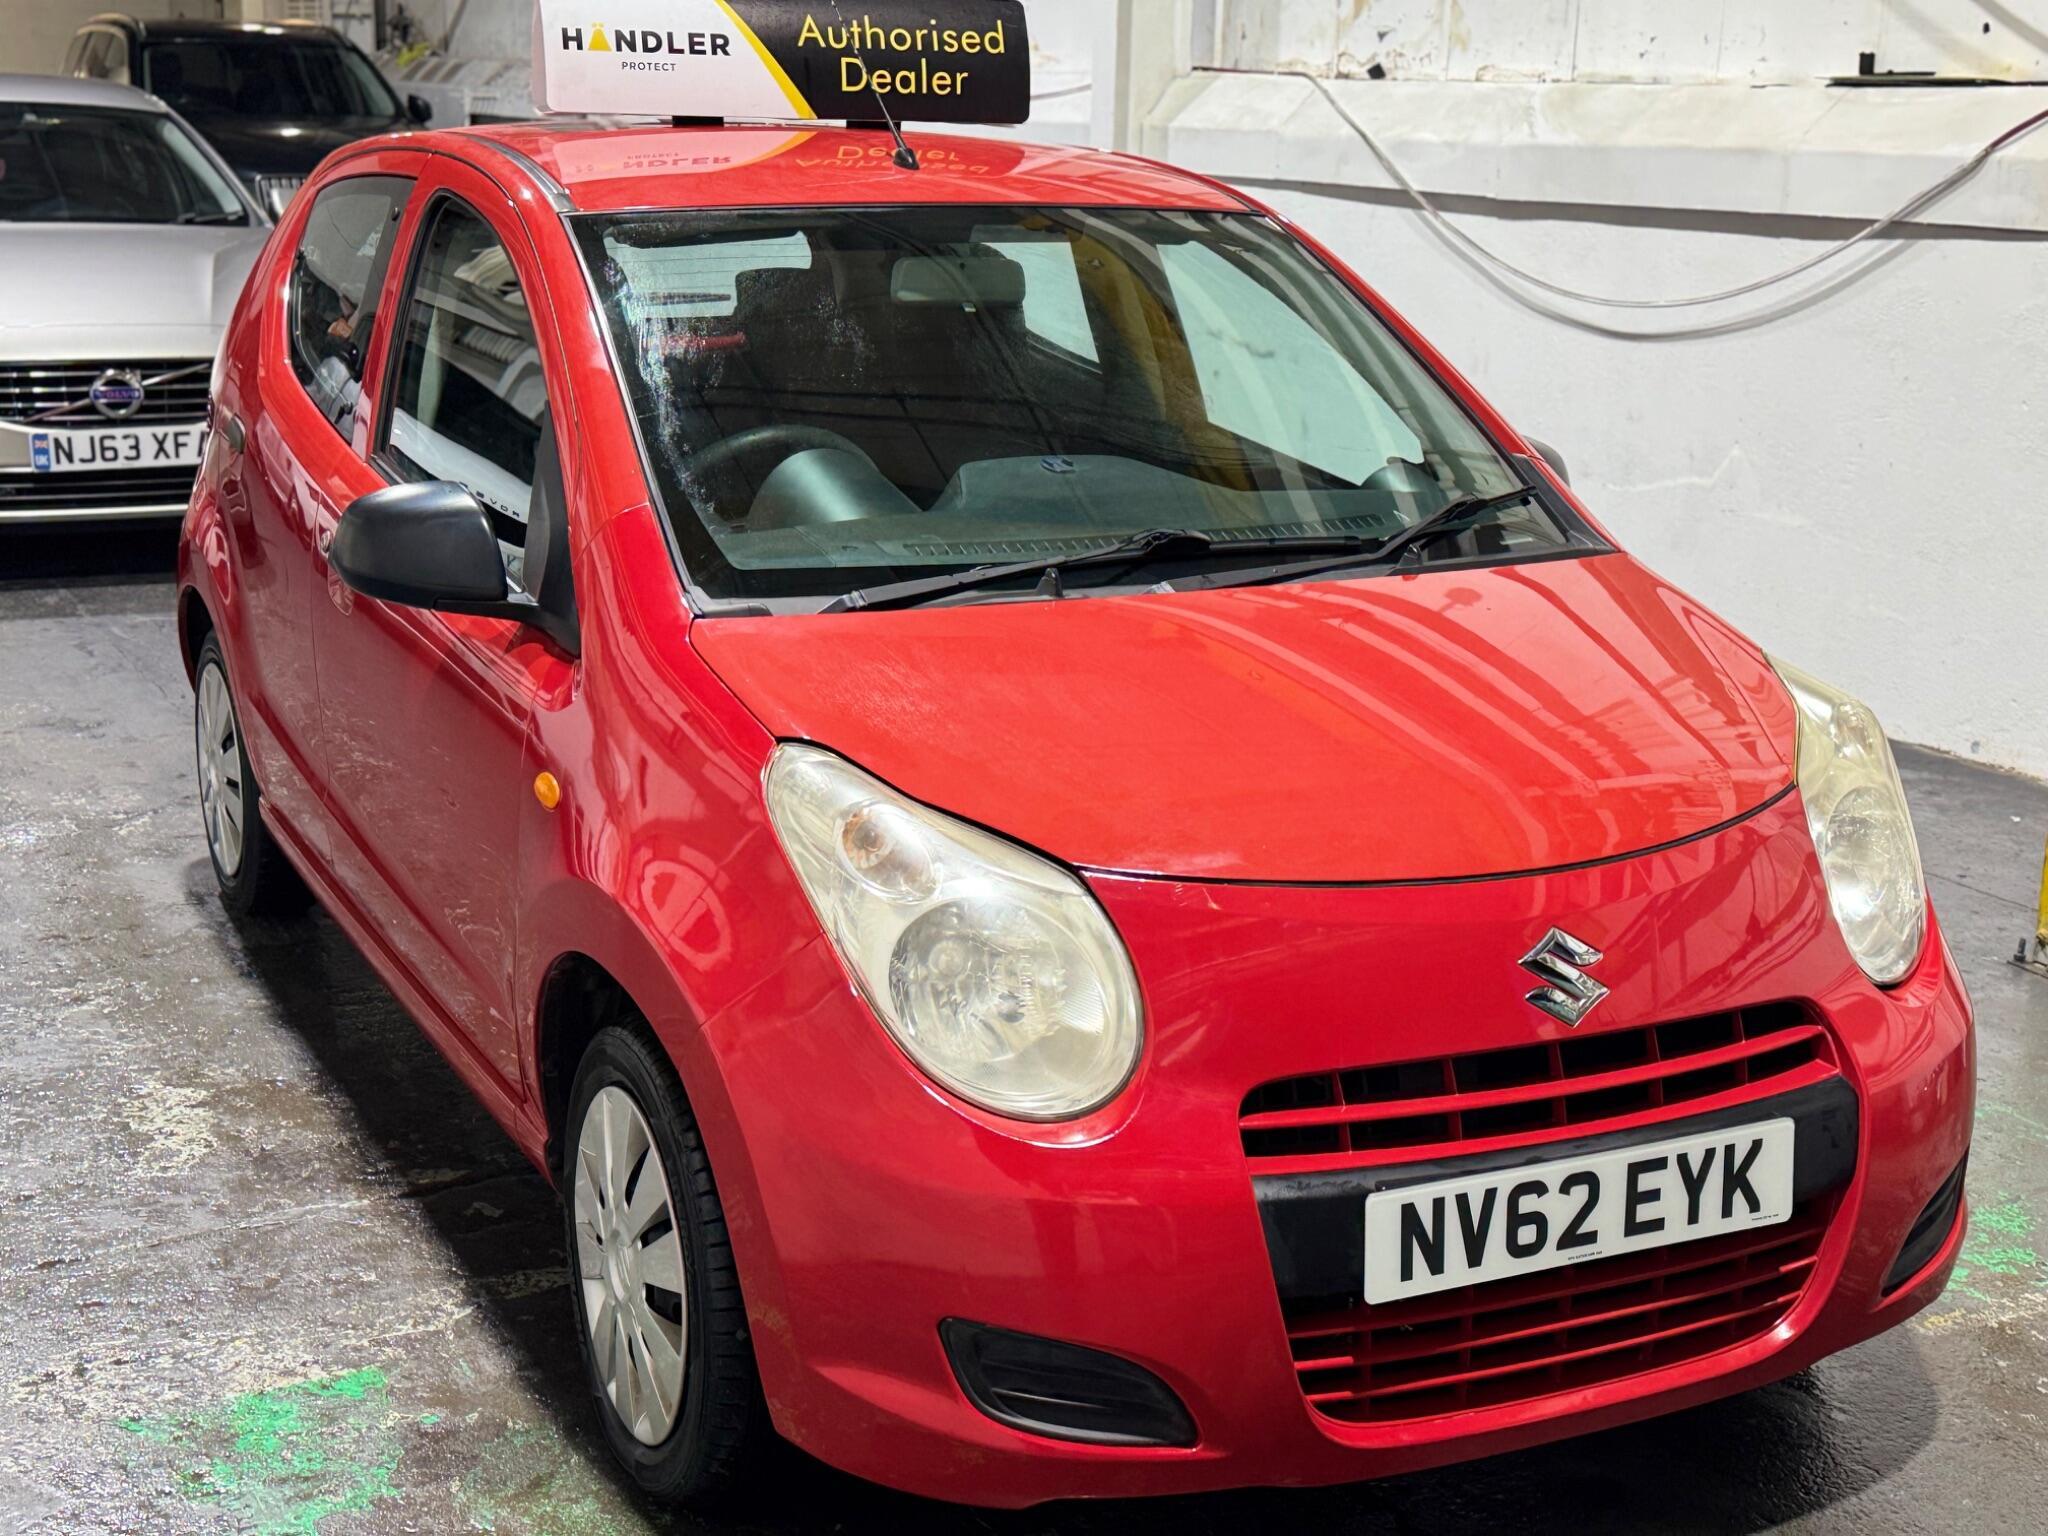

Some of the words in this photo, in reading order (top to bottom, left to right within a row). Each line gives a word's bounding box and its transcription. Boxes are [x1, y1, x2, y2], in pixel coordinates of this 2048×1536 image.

[798, 14, 1005, 54] Authorised
[621, 61, 677, 72] PROTECT
[840, 57, 969, 96] Dealer
[53, 434, 141, 464] NJ63
[1400, 1170, 1601, 1283] NV62
[1623, 1138, 1764, 1238] EYK
